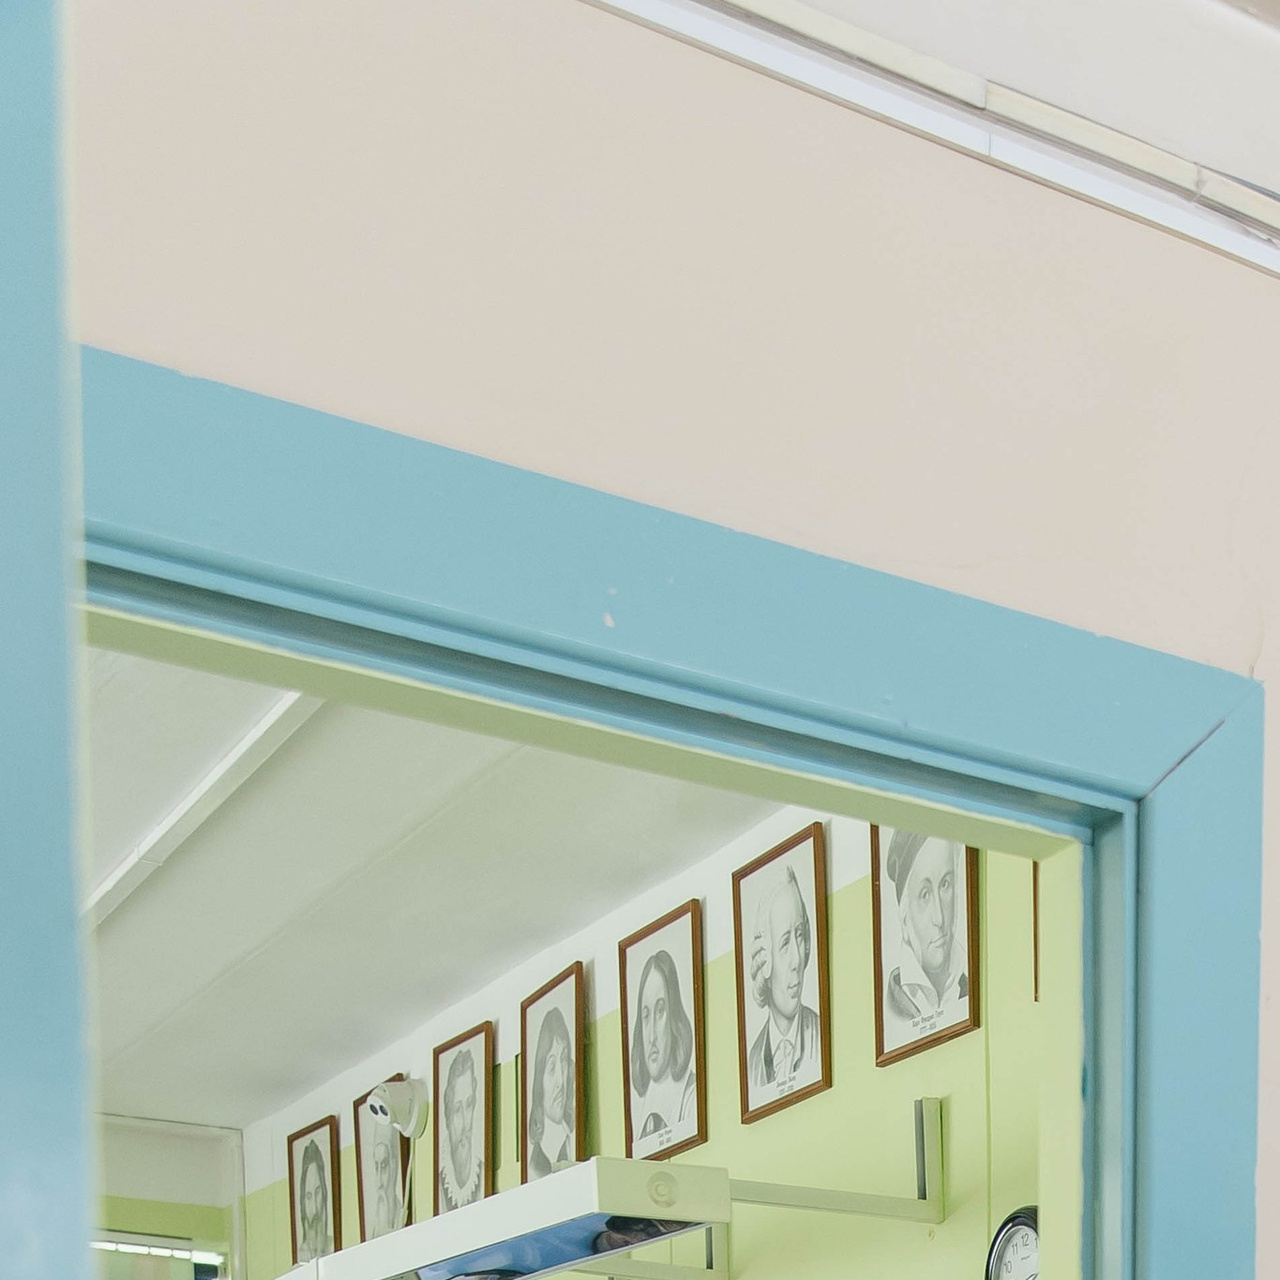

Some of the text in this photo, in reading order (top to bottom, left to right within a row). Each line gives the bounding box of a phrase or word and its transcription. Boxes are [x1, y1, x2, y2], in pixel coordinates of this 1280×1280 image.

[1021, 1233, 1029, 1246] 12
[1012, 1242, 1018, 1256] 11
[1004, 1260, 1012, 1274] 10
